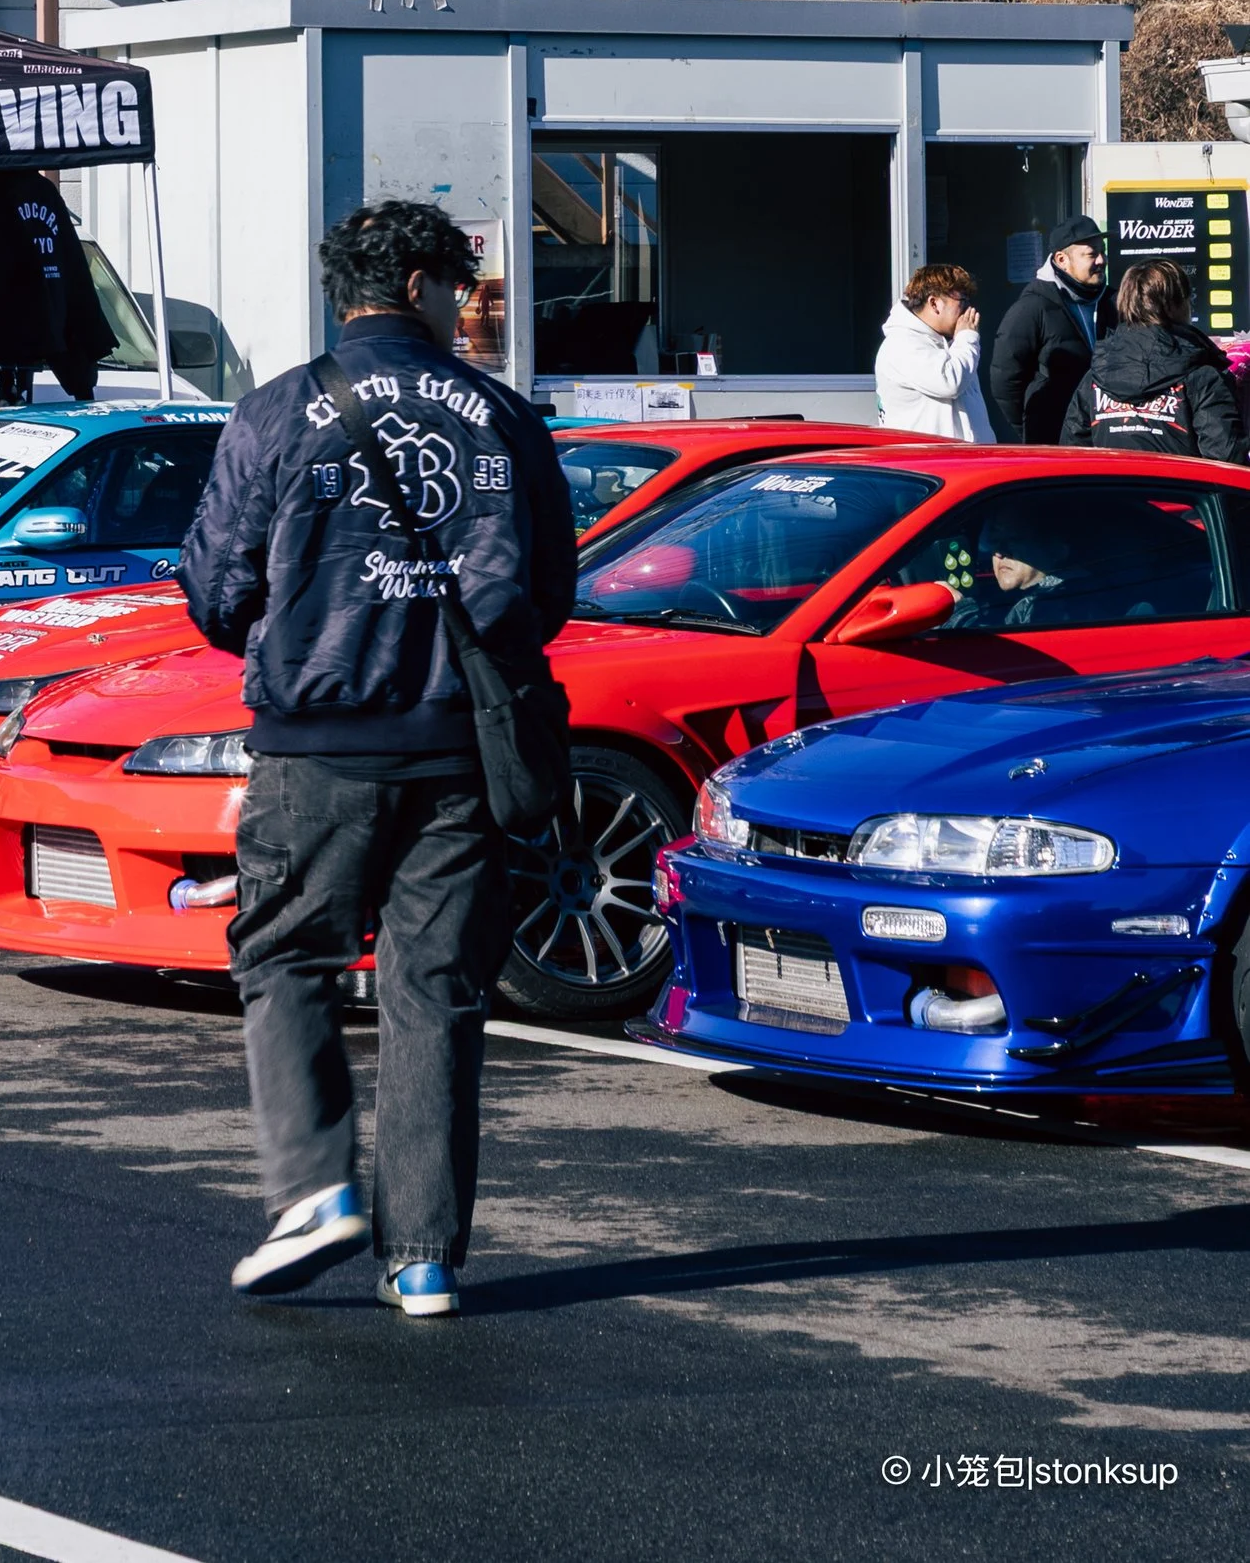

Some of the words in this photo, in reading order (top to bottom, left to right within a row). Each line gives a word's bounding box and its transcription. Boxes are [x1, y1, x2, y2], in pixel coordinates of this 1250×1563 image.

[1154, 197, 1195, 209] WONDER
[1118, 219, 1195, 240] WONDER
[416, 372, 495, 427] Walk
[312, 463, 344, 498] 19
[473, 455, 513, 490] 93
[66, 566, 127, 584] OUT
